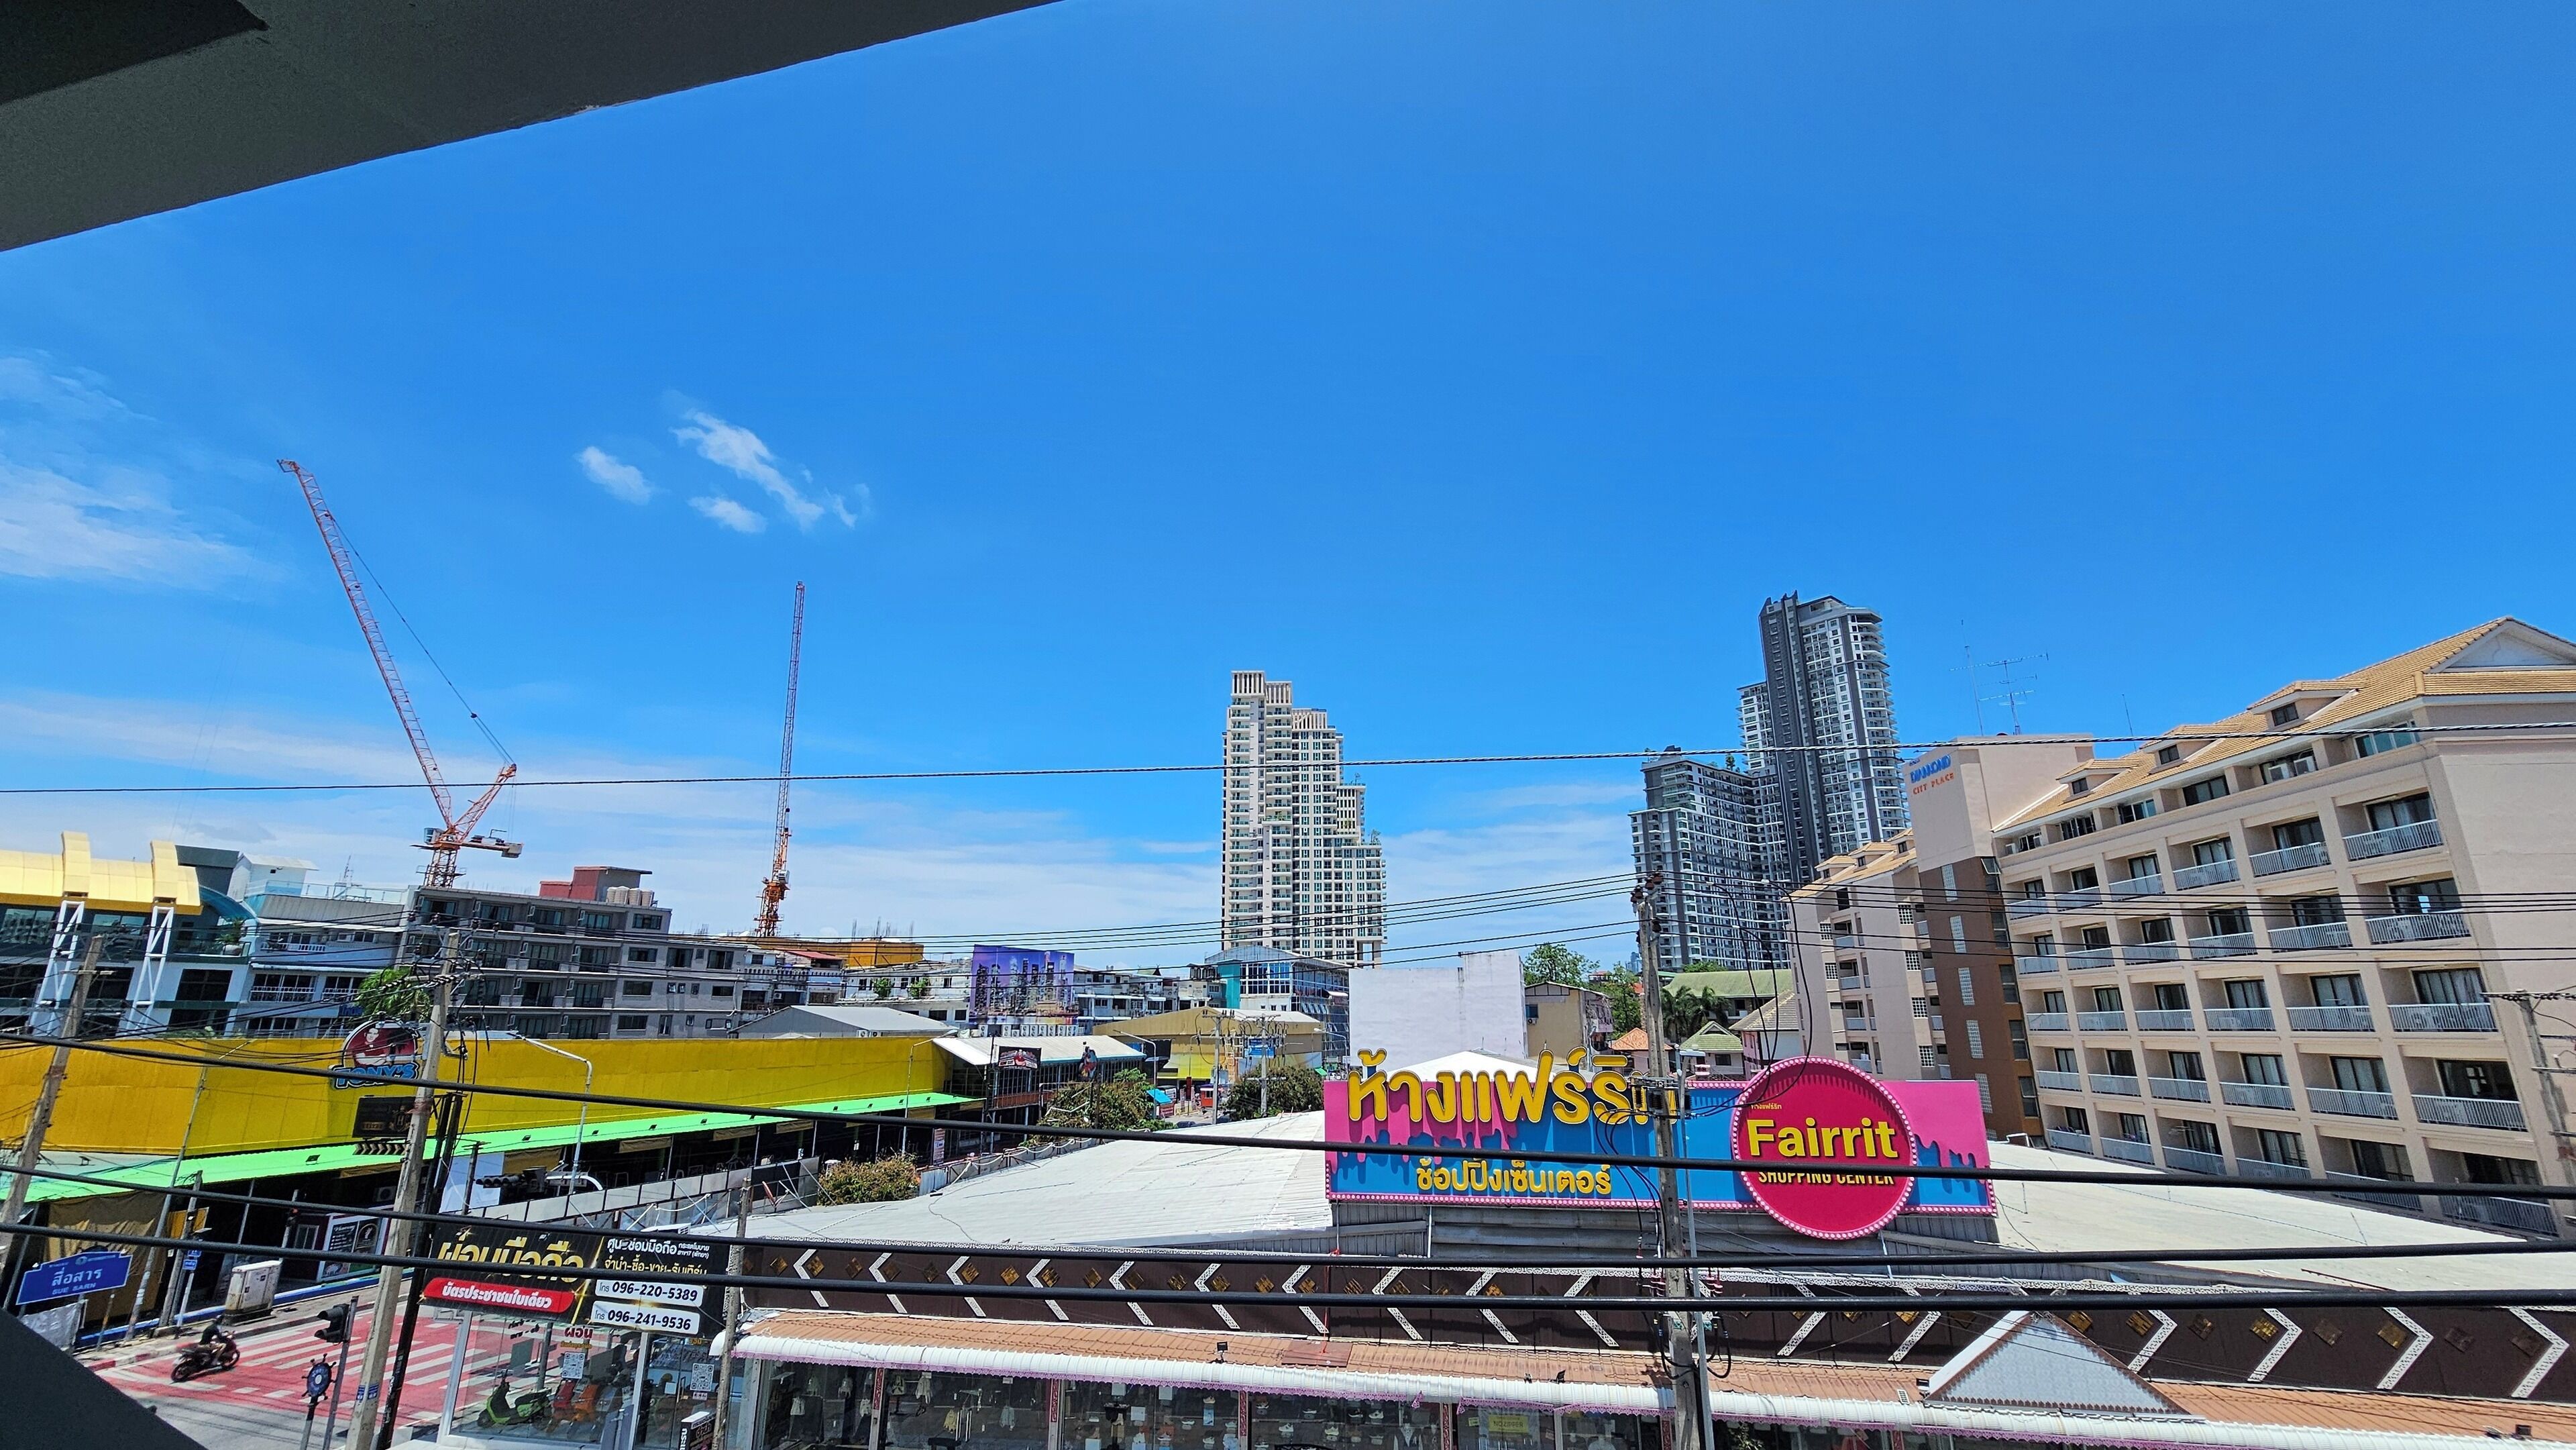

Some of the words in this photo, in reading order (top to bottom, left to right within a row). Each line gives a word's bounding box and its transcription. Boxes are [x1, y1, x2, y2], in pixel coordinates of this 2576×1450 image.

[1931, 772, 1954, 788] PLACE
[335, 1064, 415, 1086] TONY'S
[1746, 1117, 1898, 1158] Fairrit
[1416, 1157, 1611, 1194] ช้อปปิงเซ็นเตอร์
[52, 1267, 103, 1286] สื่อสาร
[52, 1287, 69, 1295] SUE
[72, 1282, 97, 1292] SARN
[441, 1282, 553, 1308] บัตรประชาชนใบเดียว
[599, 1282, 609, 1292] โทร
[612, 1281, 698, 1302] 096-220-5389
[594, 1310, 605, 1320] โทร
[607, 1309, 692, 1331] 096-241-9536
